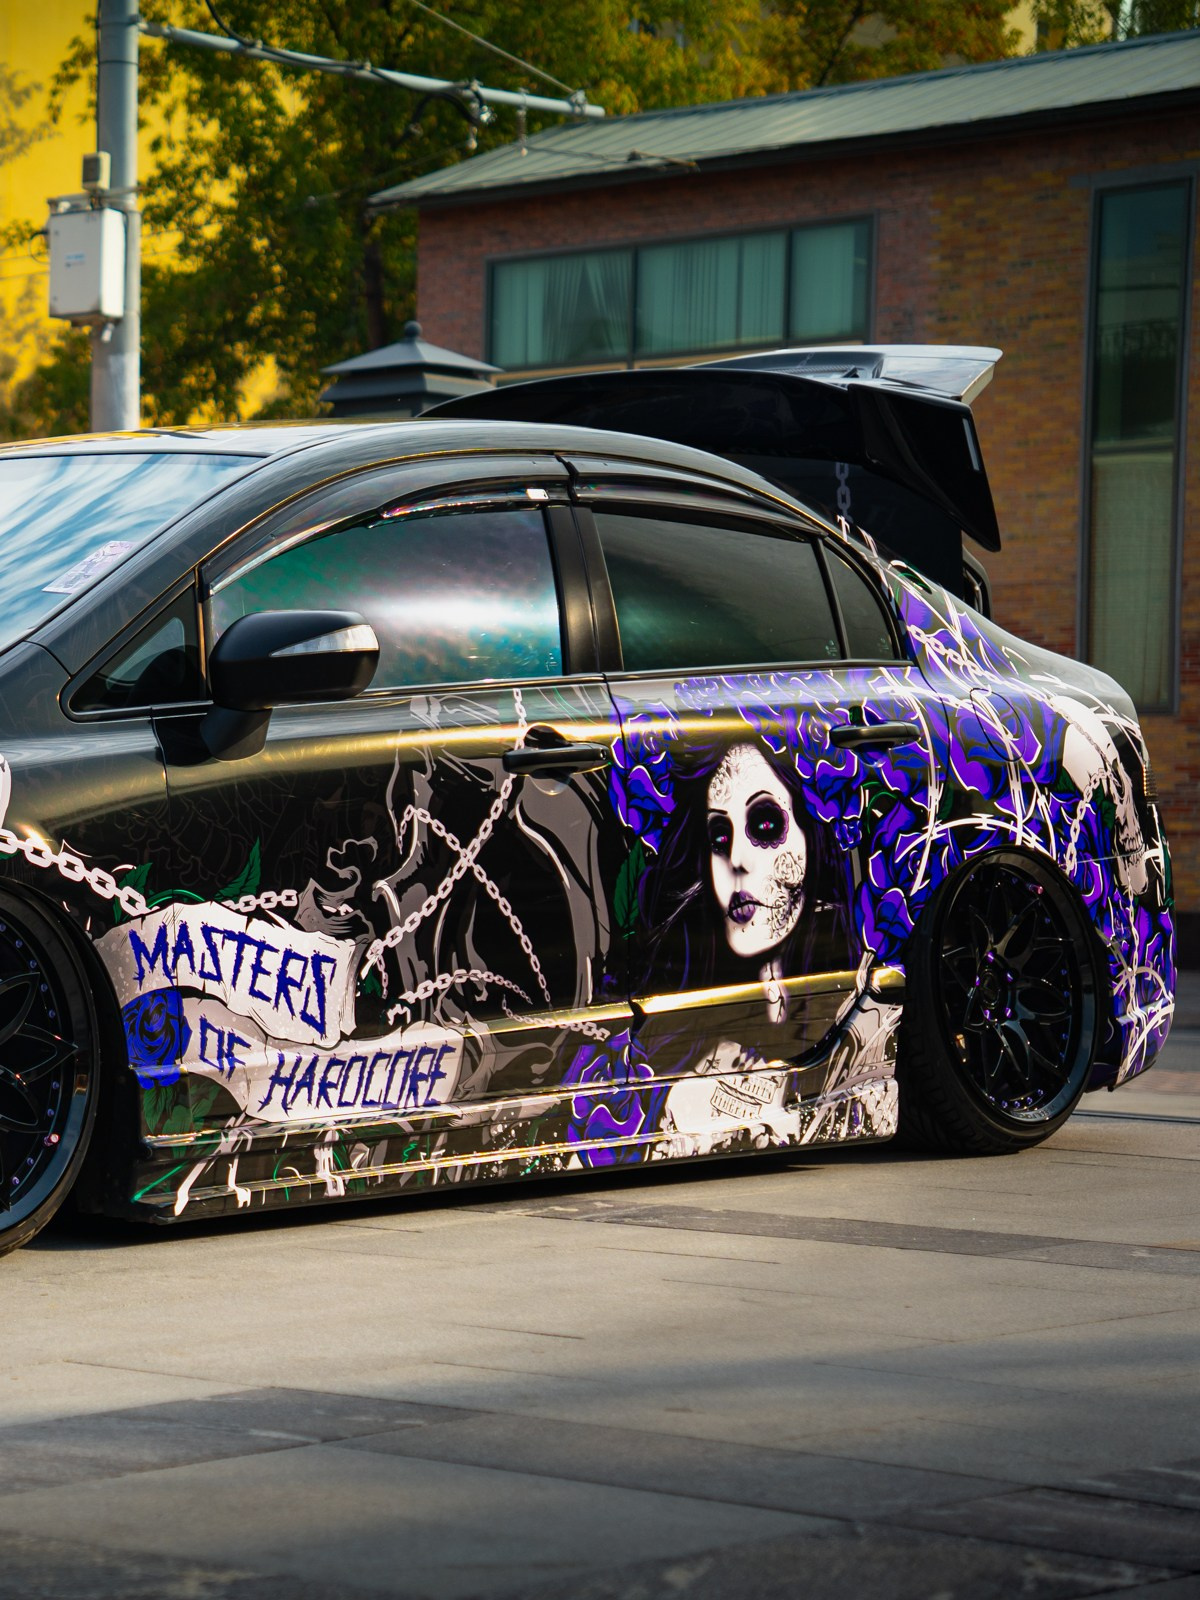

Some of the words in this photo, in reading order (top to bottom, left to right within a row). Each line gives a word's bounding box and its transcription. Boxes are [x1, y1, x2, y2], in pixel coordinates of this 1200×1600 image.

[128, 920, 337, 1039] MASTERS
[199, 1014, 251, 1082] OF
[257, 1042, 456, 1114] HARDCORE
